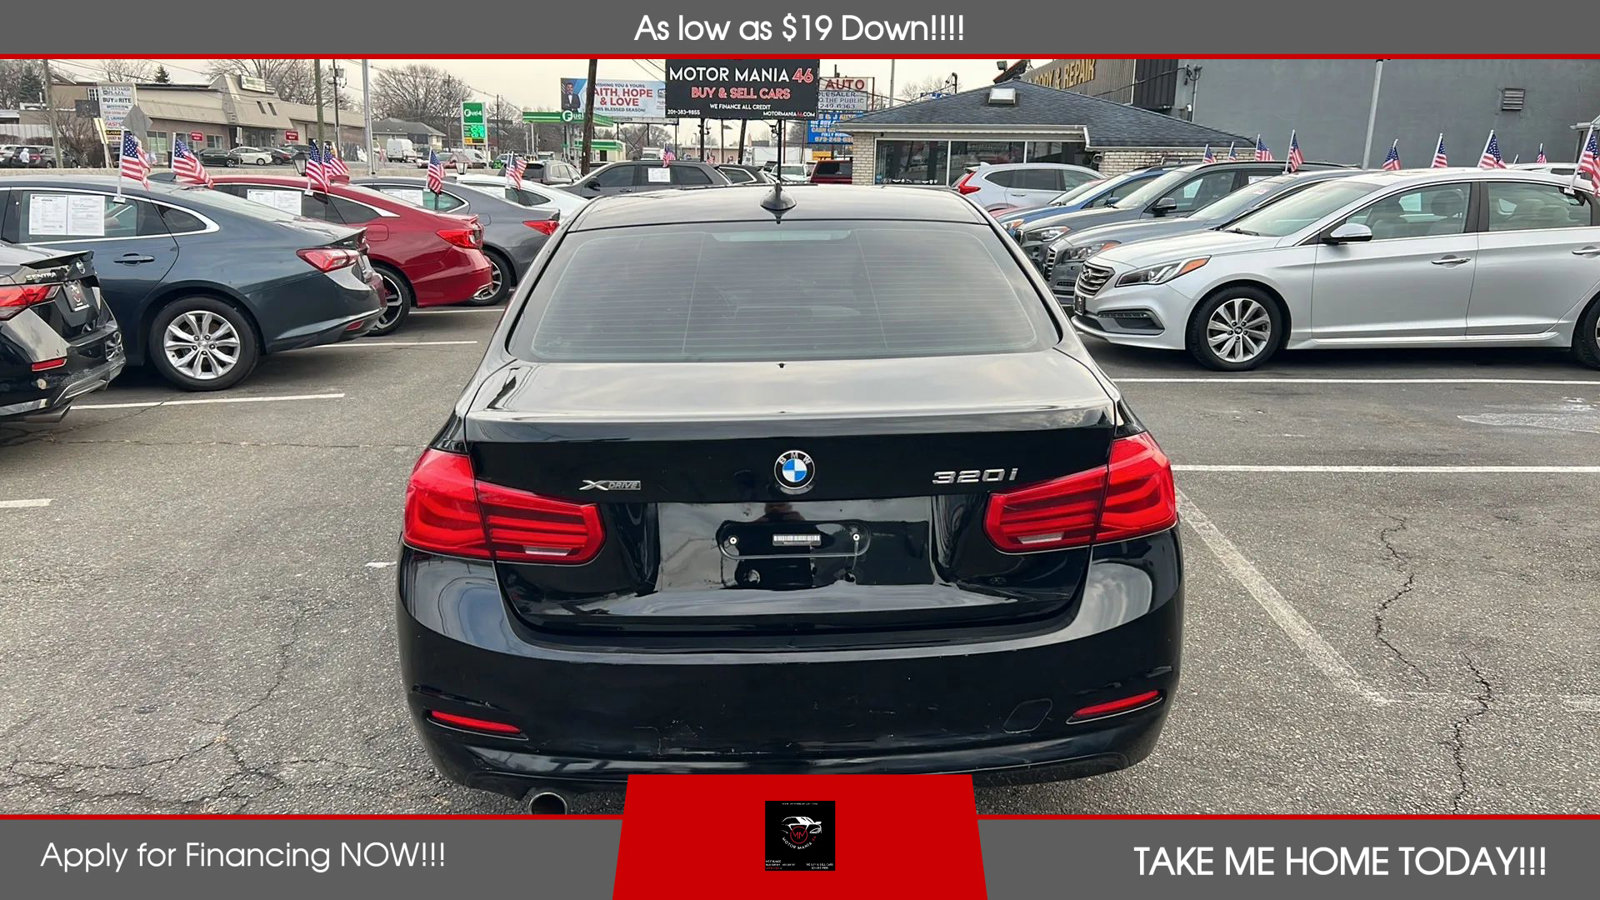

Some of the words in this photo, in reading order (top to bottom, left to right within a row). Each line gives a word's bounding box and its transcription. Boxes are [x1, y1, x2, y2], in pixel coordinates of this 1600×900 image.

[669, 67, 730, 82] MOTOR
[735, 68, 790, 82] MANIA
[792, 68, 814, 83] 46
[1064, 59, 1096, 89] REPAIR
[825, 79, 865, 90] AUTO
[594, 87, 619, 97] AITH,
[622, 88, 653, 98] HOPE
[691, 87, 716, 99] BUY
[718, 87, 727, 99] &
[730, 87, 757, 99] SELL
[759, 88, 791, 100] CARS
[600, 96, 607, 106] &
[610, 97, 639, 106] LOVE
[25, 271, 57, 281] SENTRA
[778, 452, 812, 465] BMW
[932, 468, 1018, 484] 320i
